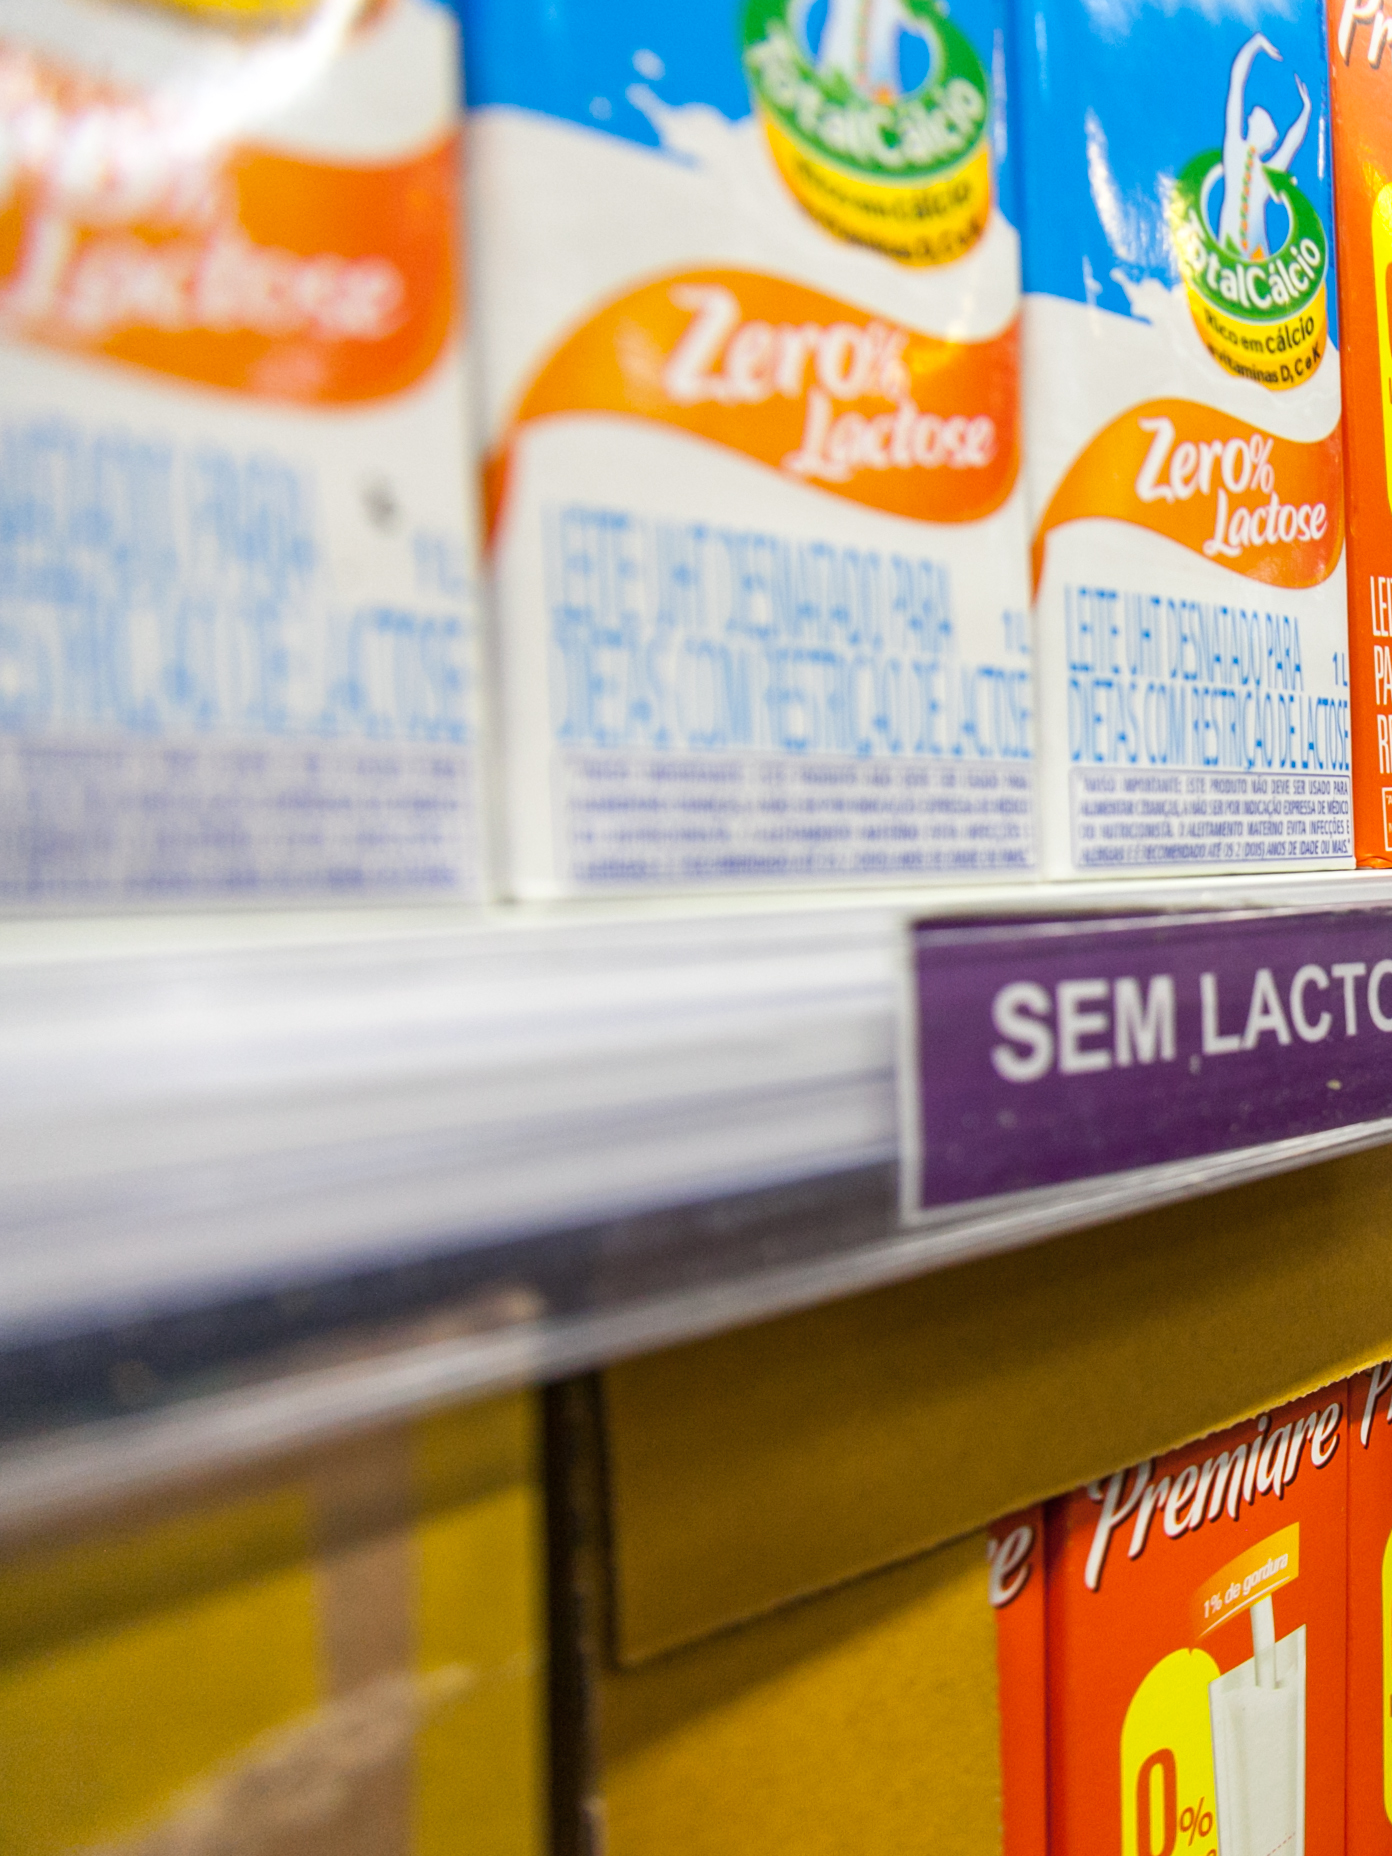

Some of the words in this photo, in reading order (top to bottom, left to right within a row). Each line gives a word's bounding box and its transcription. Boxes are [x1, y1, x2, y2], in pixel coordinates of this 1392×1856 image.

[1265, 315, 1315, 355] cálcio
[1135, 416, 1275, 503] Zero%
[1202, 487, 1328, 557] Lactose
[1299, 693, 1350, 771] LACTOSE
[1271, 779, 1290, 795] DEVE
[1293, 779, 1306, 795] SER
[1309, 780, 1331, 795] USADO
[1333, 780, 1348, 795] PARA
[1284, 800, 1316, 815] EXPRESSA
[1317, 800, 1326, 815] DE
[1288, 840, 1297, 855] DE
[1320, 839, 1330, 854] OU
[990, 975, 1177, 1083] SEM
[1084, 1402, 1341, 1590] Premiare
[1204, 1591, 1222, 1618] 1%
[1224, 1582, 1241, 1605] de
[1242, 1553, 1288, 1596] gordura
[1136, 1748, 1213, 1856] 0%
